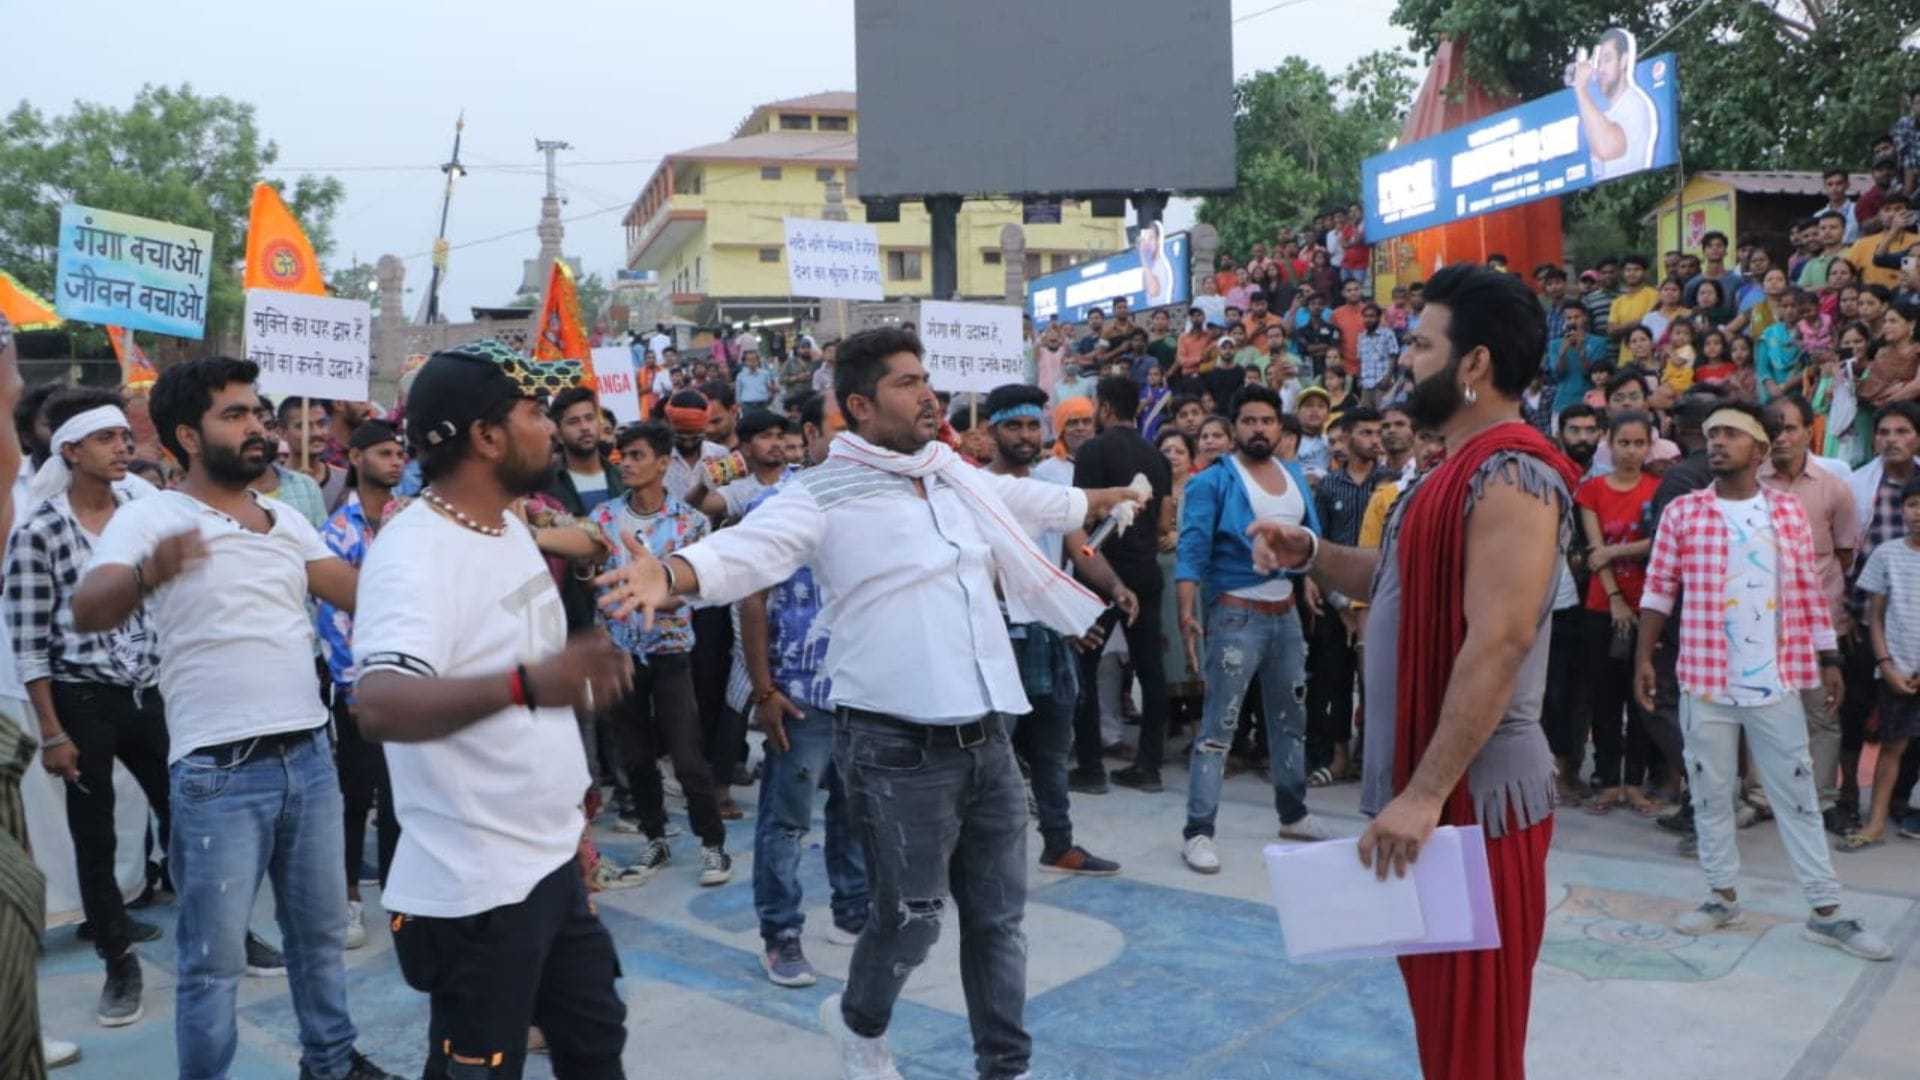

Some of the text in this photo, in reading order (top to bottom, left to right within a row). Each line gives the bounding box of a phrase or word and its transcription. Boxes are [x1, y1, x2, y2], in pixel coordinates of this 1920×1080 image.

[74, 216, 204, 278] गंगा बचाओ,
[65, 263, 135, 309] जीवन
[253, 306, 289, 338] मुक्ति
[291, 316, 308, 337] का
[310, 319, 330, 338] यह
[332, 321, 351, 341] द्वार
[926, 316, 948, 339] गंगा
[950, 319, 961, 339] भी
[965, 323, 990, 341] उदास
[278, 354, 293, 375] का
[942, 355, 956, 370] रहा
[960, 355, 974, 377] बुरा
[596, 373, 631, 393] ANGA
